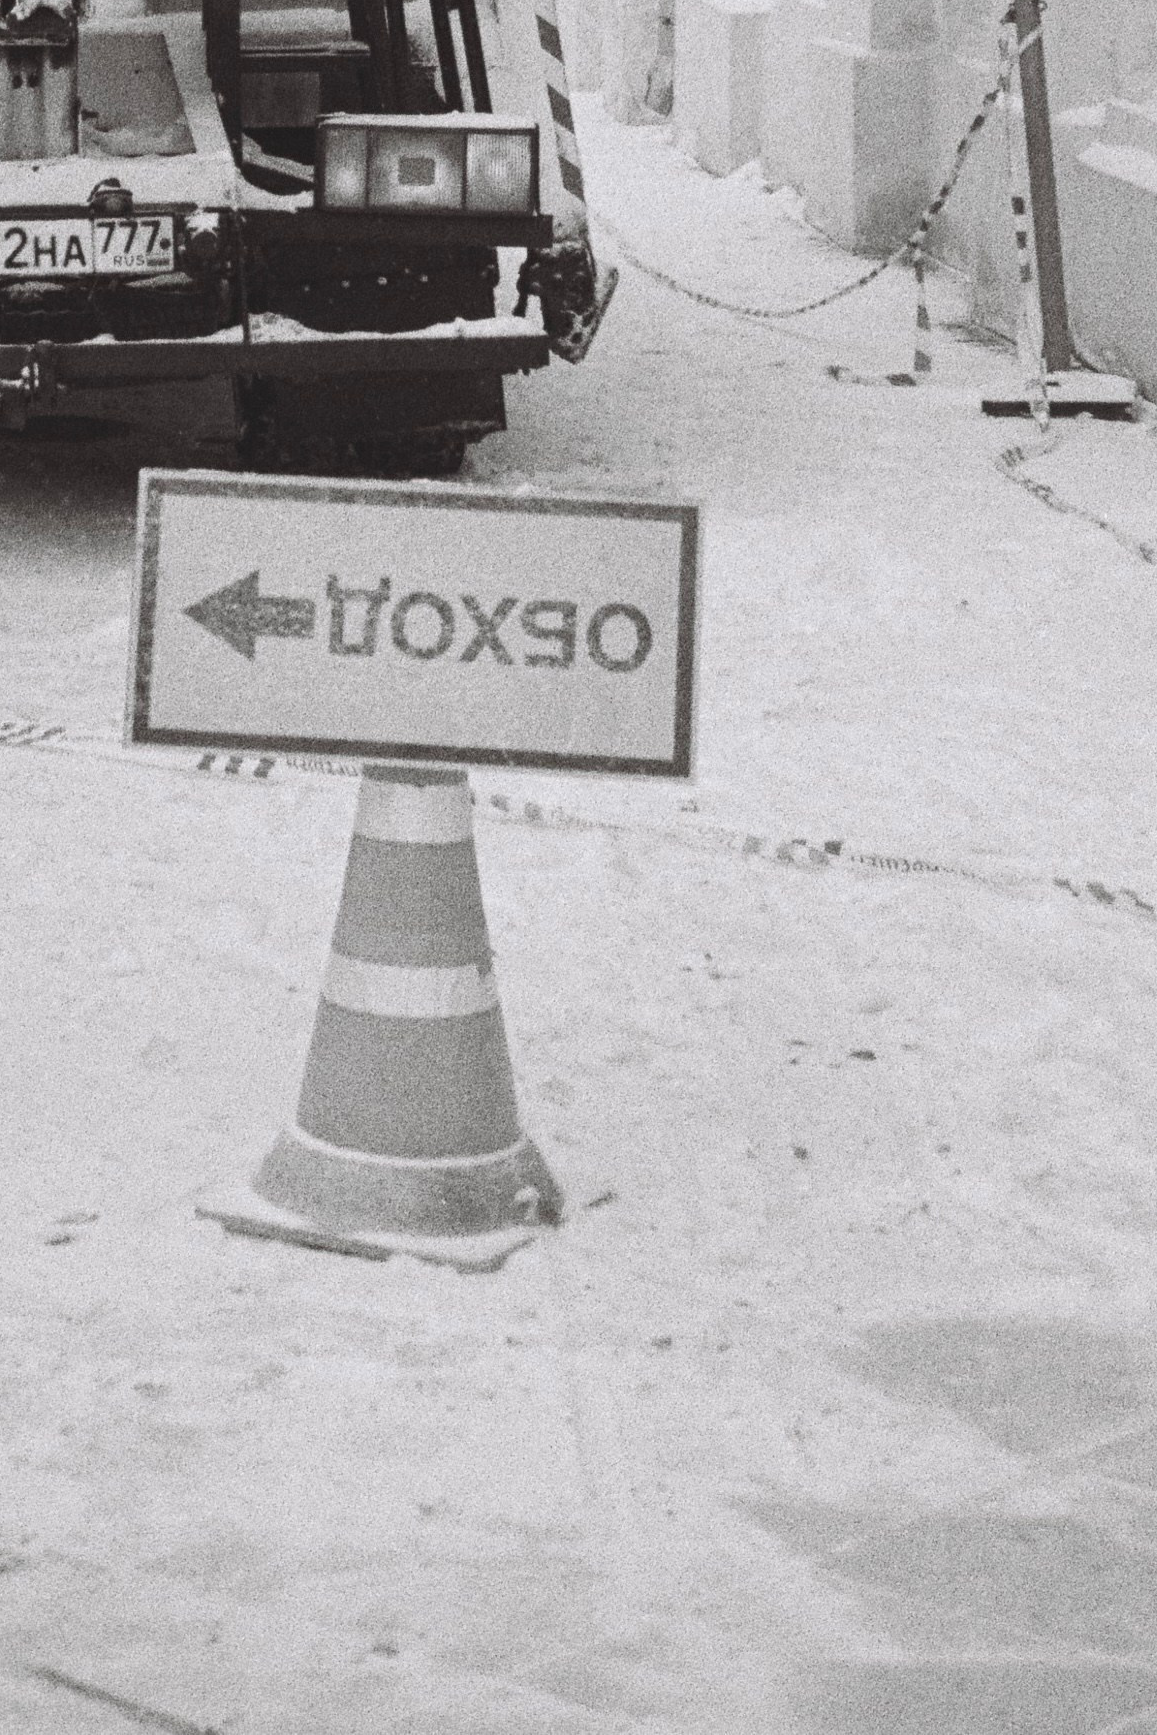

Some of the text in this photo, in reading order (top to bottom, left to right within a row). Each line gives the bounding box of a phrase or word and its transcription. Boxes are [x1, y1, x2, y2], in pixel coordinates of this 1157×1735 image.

[96, 219, 160, 254] 777
[113, 255, 145, 267] RUS
[325, 573, 654, 672] ОБХОД
